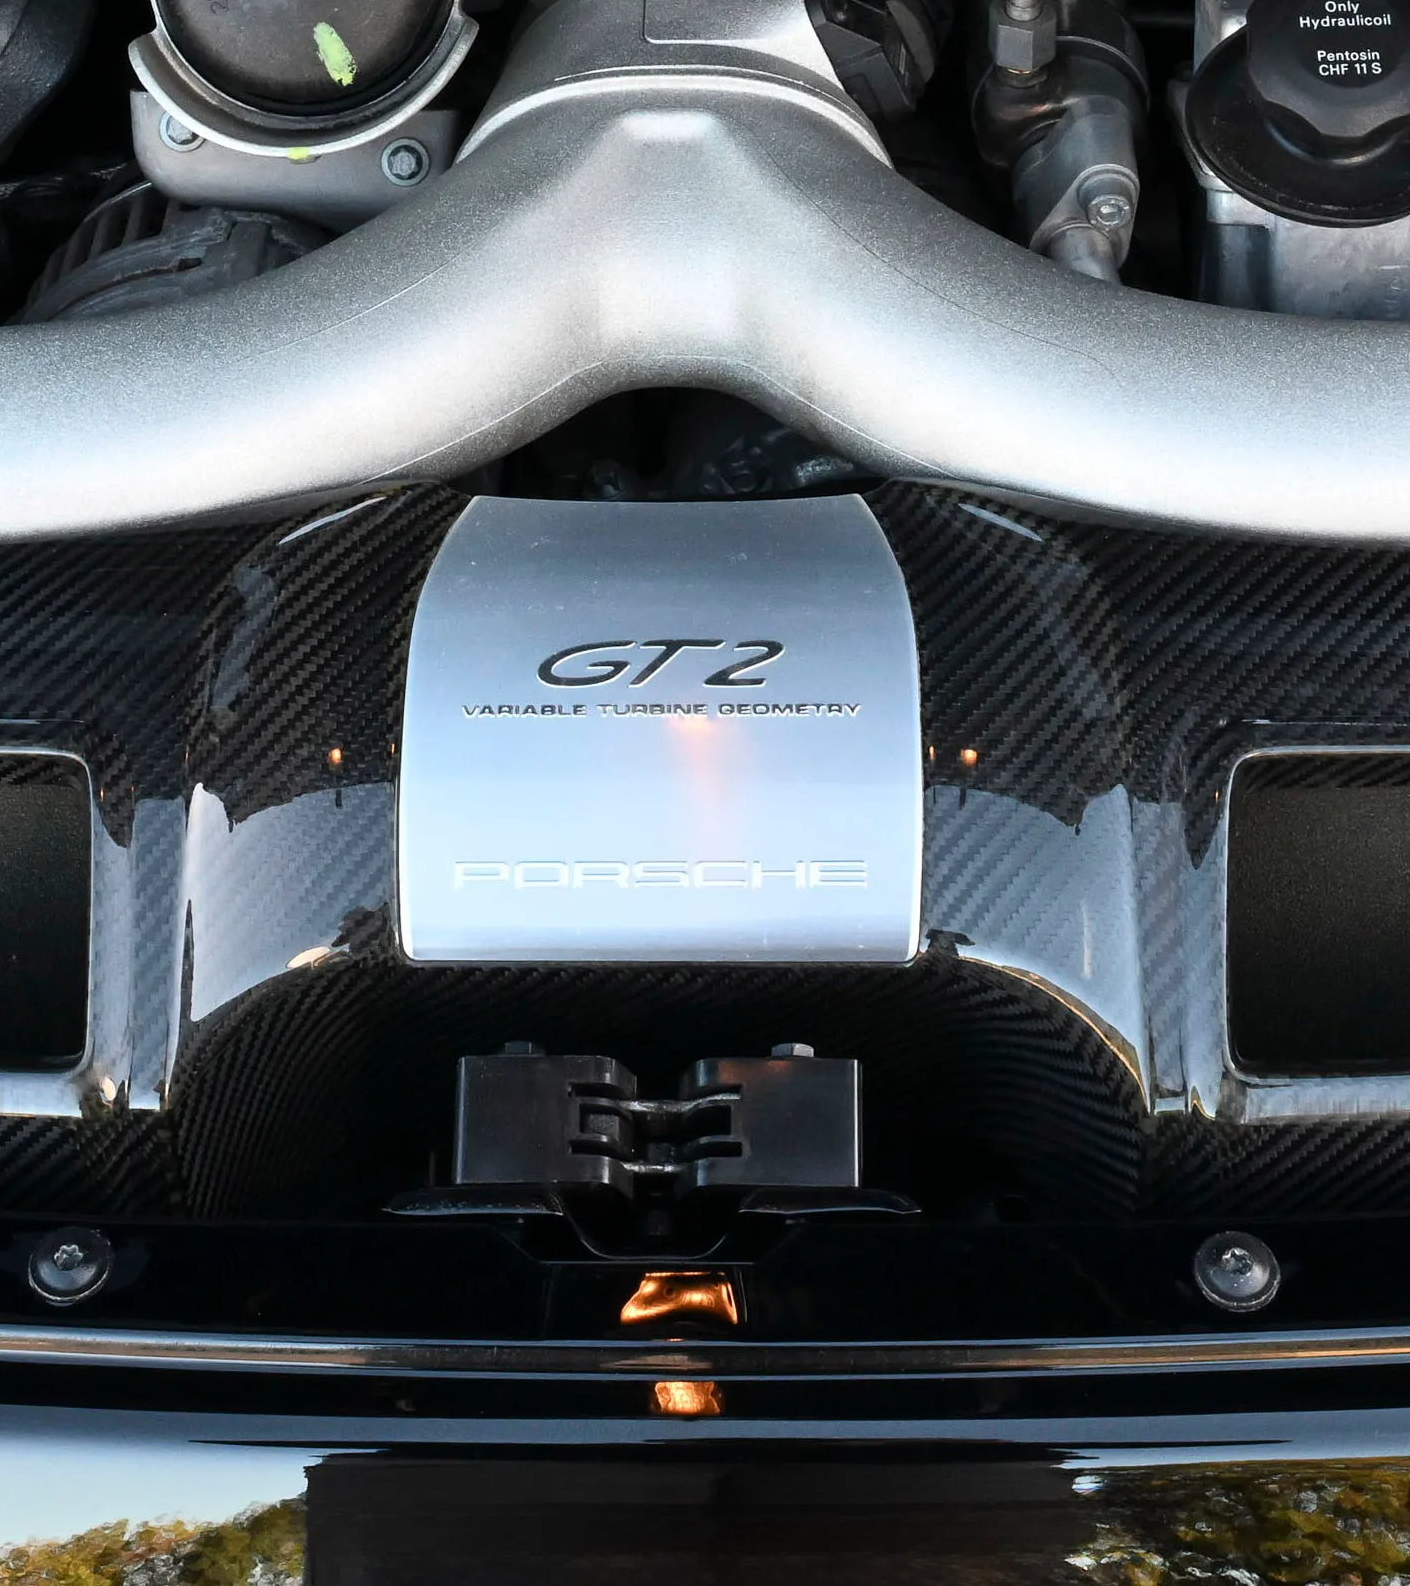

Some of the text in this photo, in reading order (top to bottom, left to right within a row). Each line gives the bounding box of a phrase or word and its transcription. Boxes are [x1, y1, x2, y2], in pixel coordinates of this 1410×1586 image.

[1324, 0, 1360, 14] Only
[1298, 13, 1392, 31] Hydraulicoil
[1316, 49, 1381, 62] Pentosin
[1318, 62, 1383, 76] CHF 11 S
[461, 703, 862, 718] VARIABLE TURBINE GEOMETRY
[454, 860, 868, 889] PORSCHE
